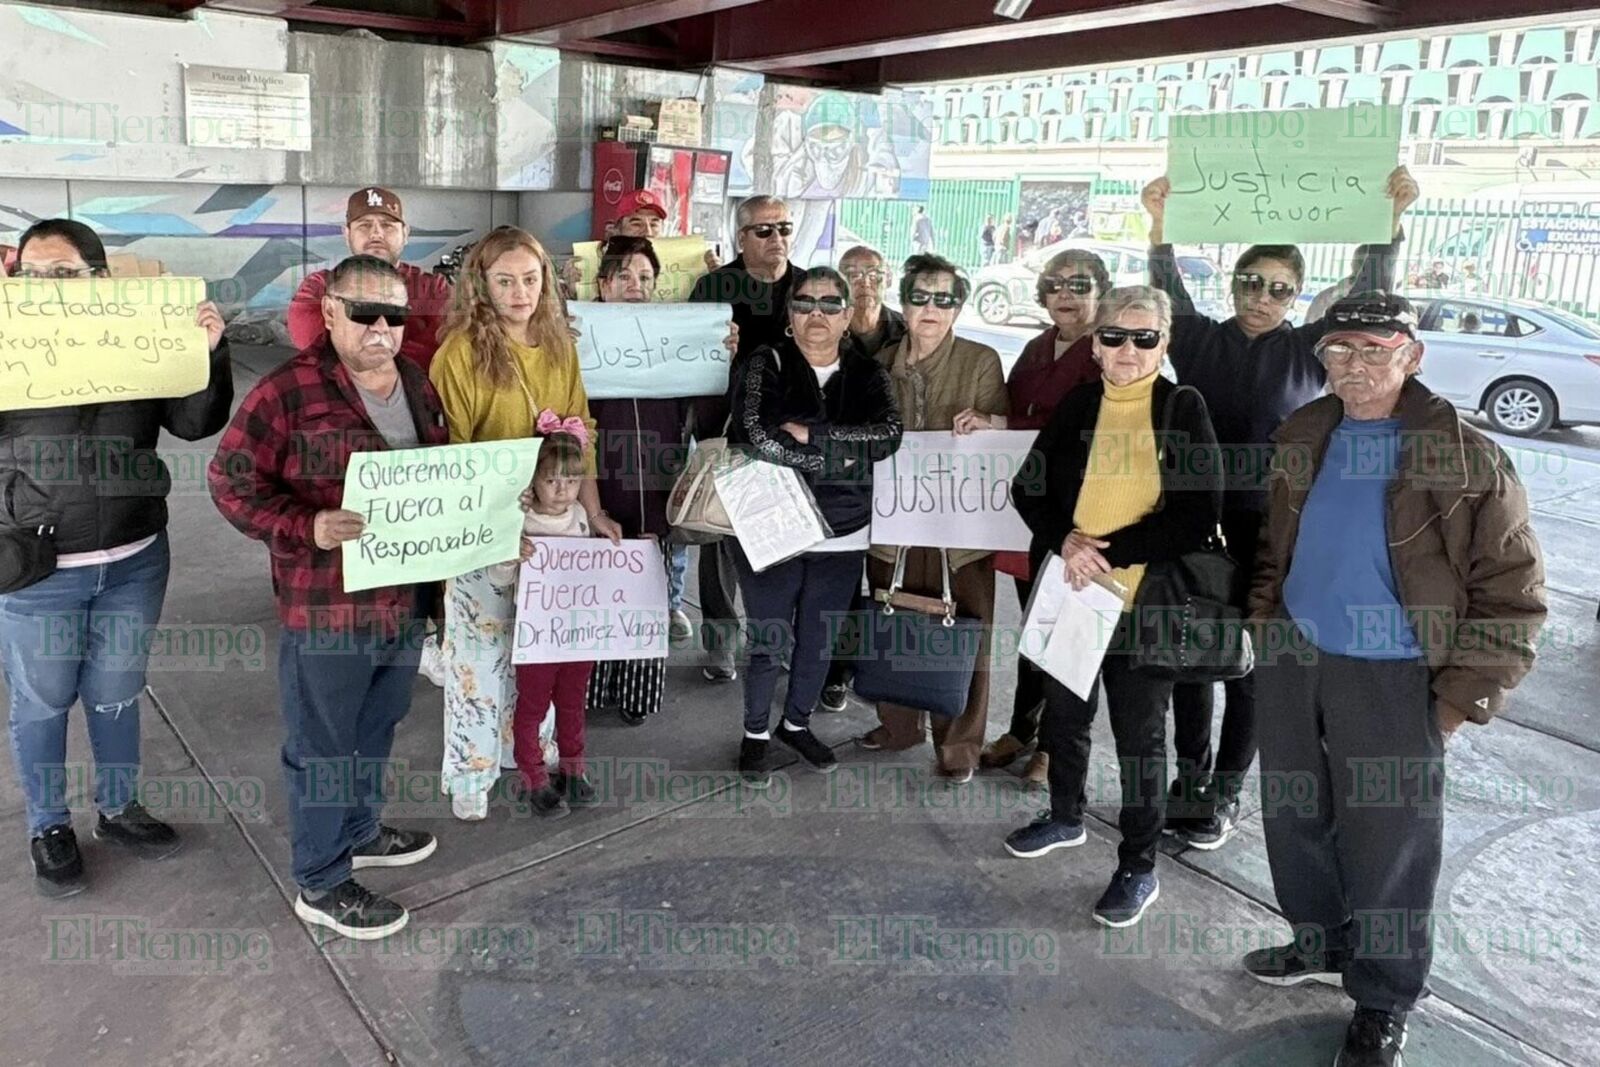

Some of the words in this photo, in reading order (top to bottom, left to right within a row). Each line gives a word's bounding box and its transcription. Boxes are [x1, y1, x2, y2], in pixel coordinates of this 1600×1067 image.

[1169, 140, 1366, 196] Justicia
[366, 189, 383, 206] LA
[1251, 194, 1343, 224] favor
[160, 303, 196, 329] por
[97, 330, 126, 348] de
[579, 316, 727, 371] Justicia
[358, 459, 477, 490] Queremos
[875, 453, 1017, 518] Justicia
[363, 497, 444, 524] Fuera
[458, 485, 484, 511] al
[358, 524, 494, 565] Responsable
[527, 541, 644, 574] Queremos
[524, 581, 600, 611] Fuera
[612, 588, 626, 604] a
[618, 613, 667, 647] Vargas
